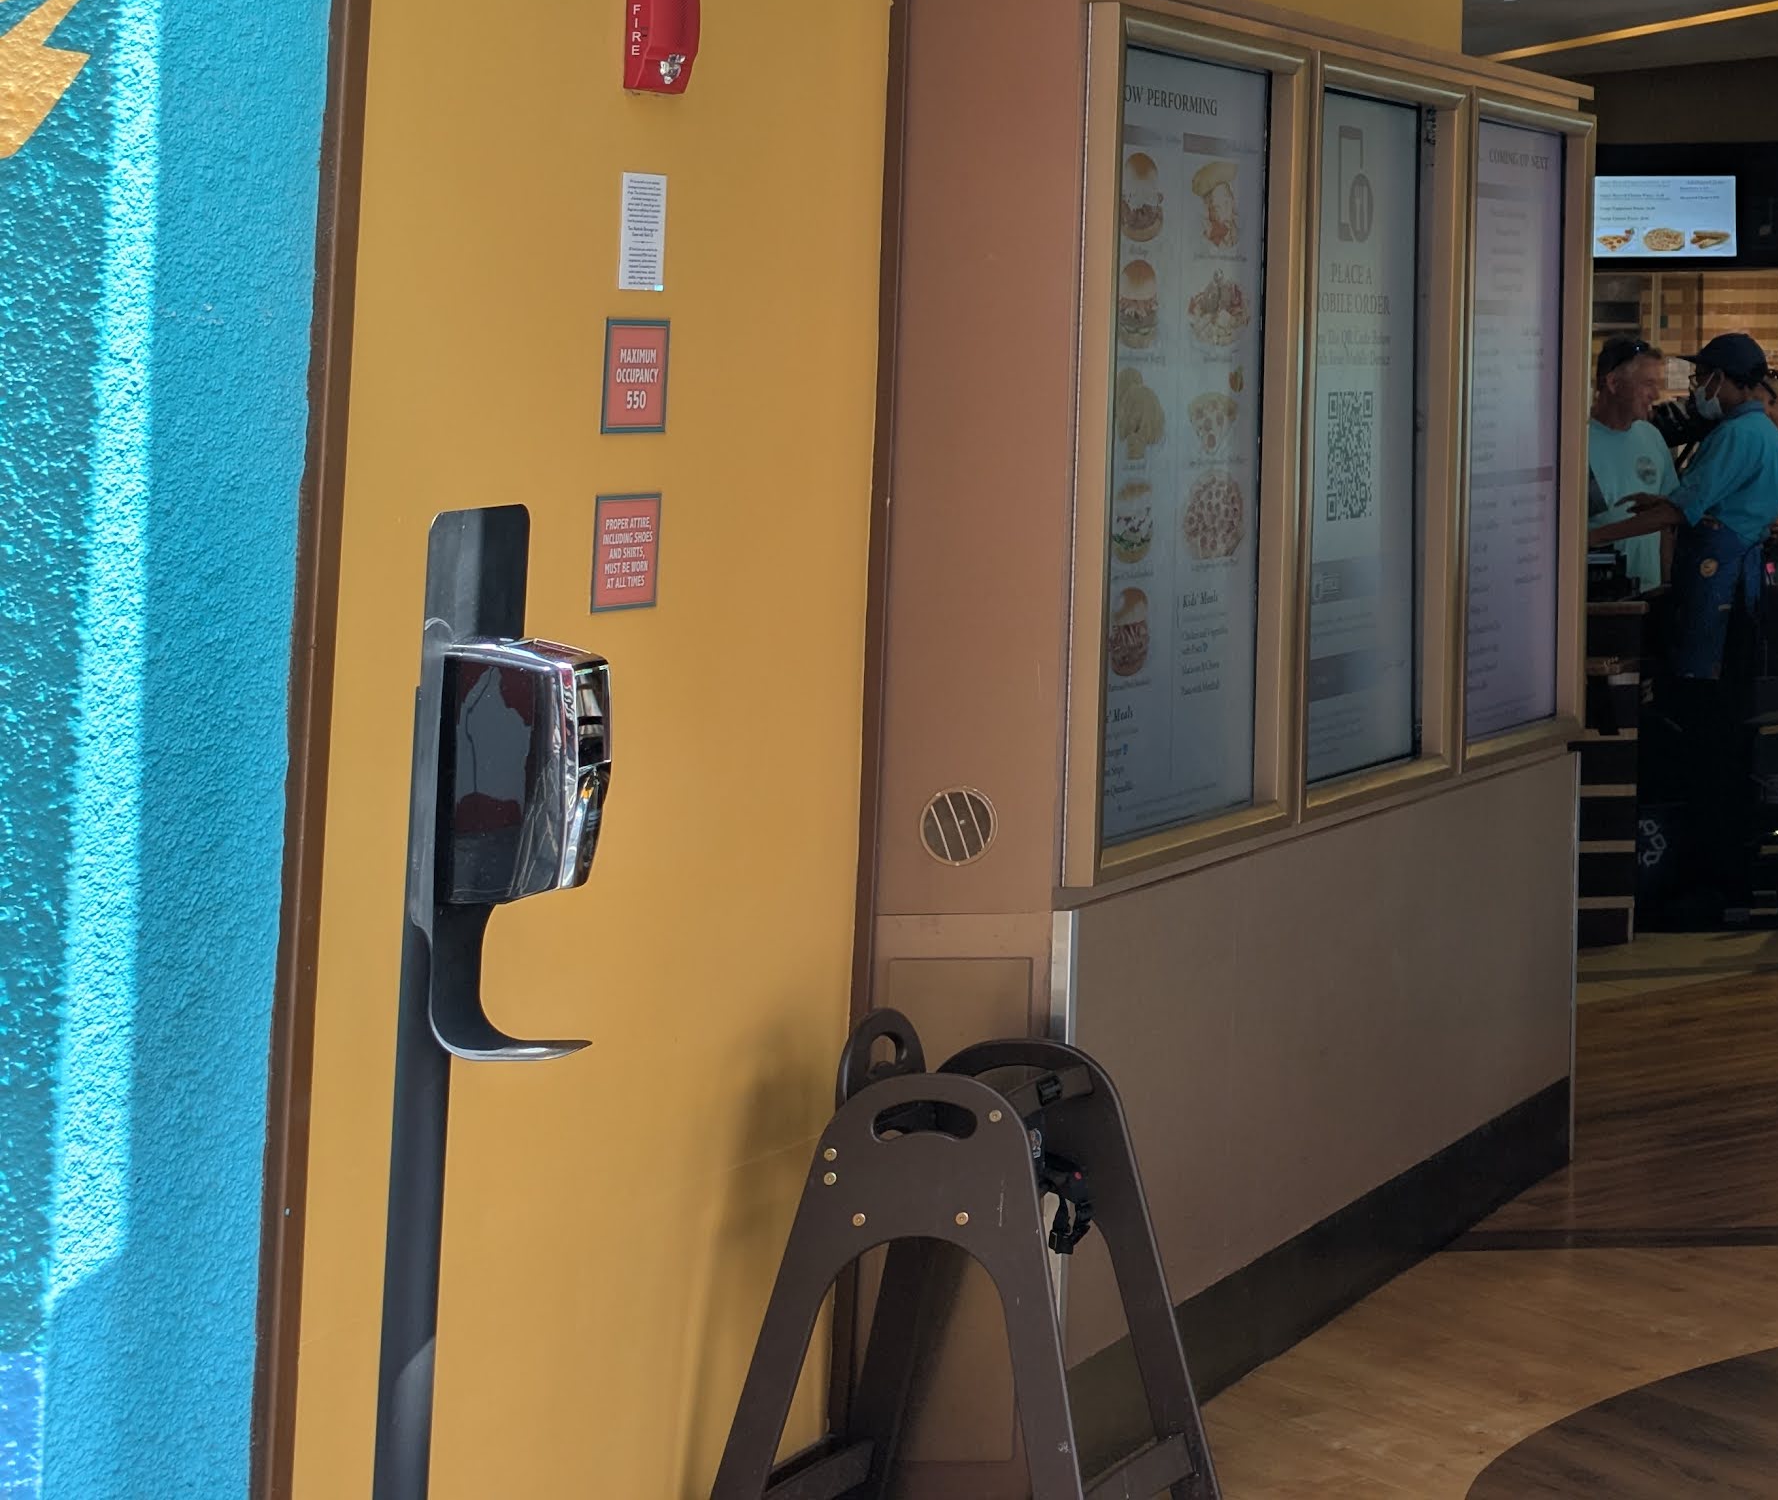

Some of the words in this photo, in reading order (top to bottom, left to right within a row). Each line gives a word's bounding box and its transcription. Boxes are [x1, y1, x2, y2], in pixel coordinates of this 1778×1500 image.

[632, 4, 642, 56] FIRE
[1124, 84, 1144, 104] OW
[1147, 88, 1218, 116] PERFORMING
[1329, 263, 1364, 285] PLACE
[1365, 267, 1373, 285] A
[1354, 293, 1391, 315] ORDER
[619, 348, 657, 364] MAXIMUM
[616, 368, 659, 383] OCCUPANCY
[626, 390, 647, 409] 550
[605, 518, 629, 530] PROPER
[629, 516, 652, 530] ATTIRE,
[603, 532, 633, 545] INCLUDING
[634, 531, 653, 543] SHOES
[609, 548, 622, 560] AND
[622, 546, 645, 560] SHIRTS,
[604, 562, 621, 575] MUST
[622, 562, 630, 573] BE
[631, 560, 649, 572] WORN
[606, 577, 614, 589] AT
[615, 576, 627, 588] ALL
[627, 575, 645, 588] TIMES
